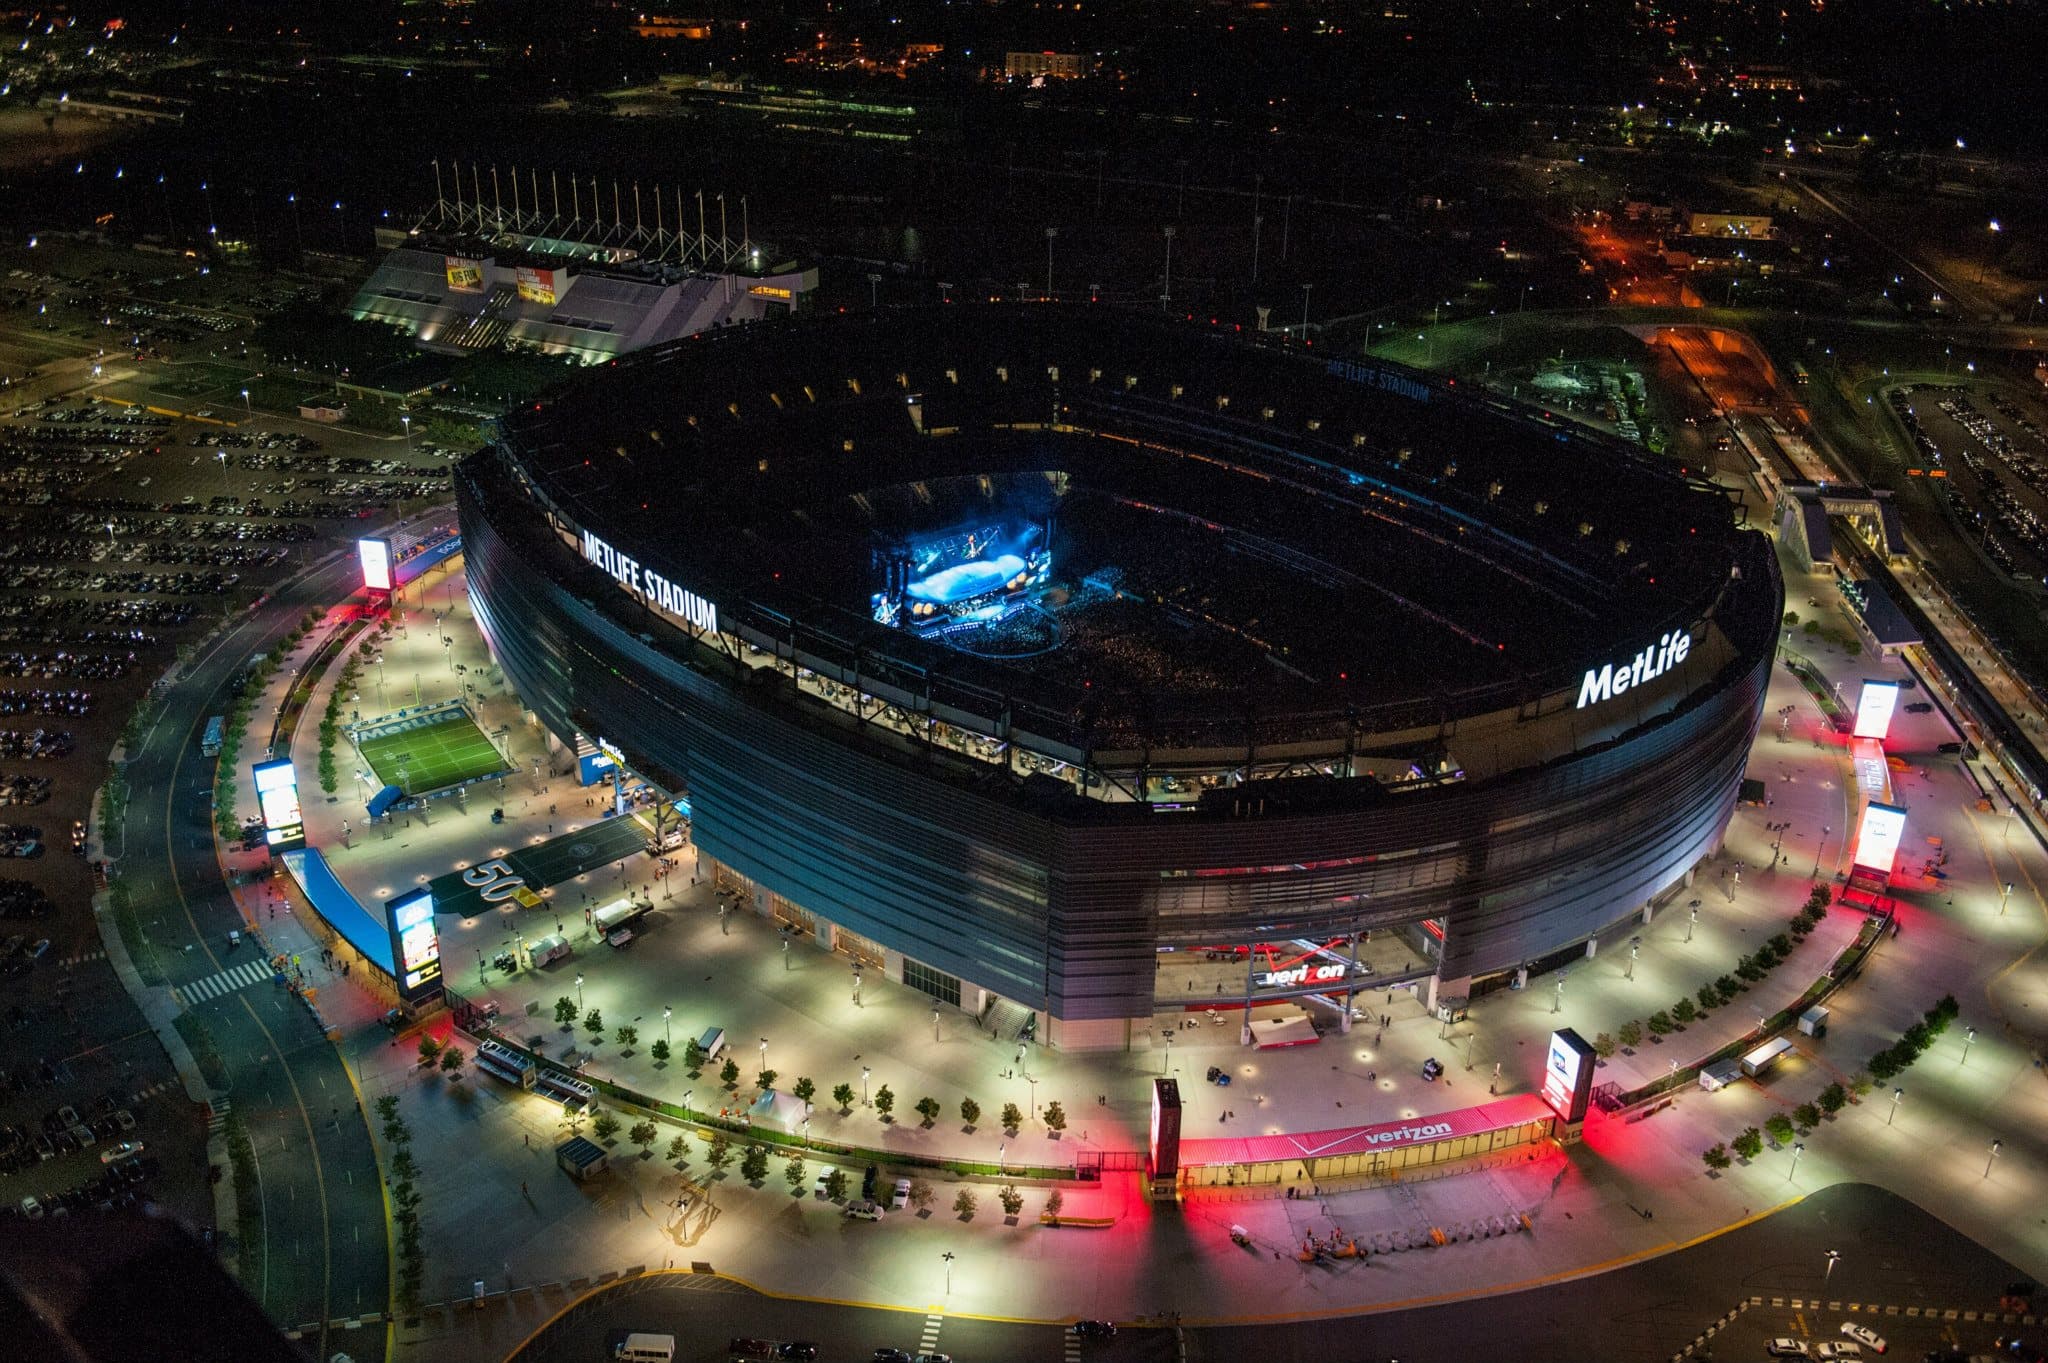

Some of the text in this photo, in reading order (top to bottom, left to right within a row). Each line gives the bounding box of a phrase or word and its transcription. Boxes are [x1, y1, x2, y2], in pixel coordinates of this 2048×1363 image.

[1328, 359, 1430, 403] METLIFE STADIUM
[584, 529, 717, 634] METLIFE STADIUM
[1576, 628, 1691, 709] MetLife
[360, 711, 462, 742] MetLife
[463, 859, 527, 902] 50
[1266, 964, 1346, 985] verizon
[1365, 1122, 1453, 1144] verizon
